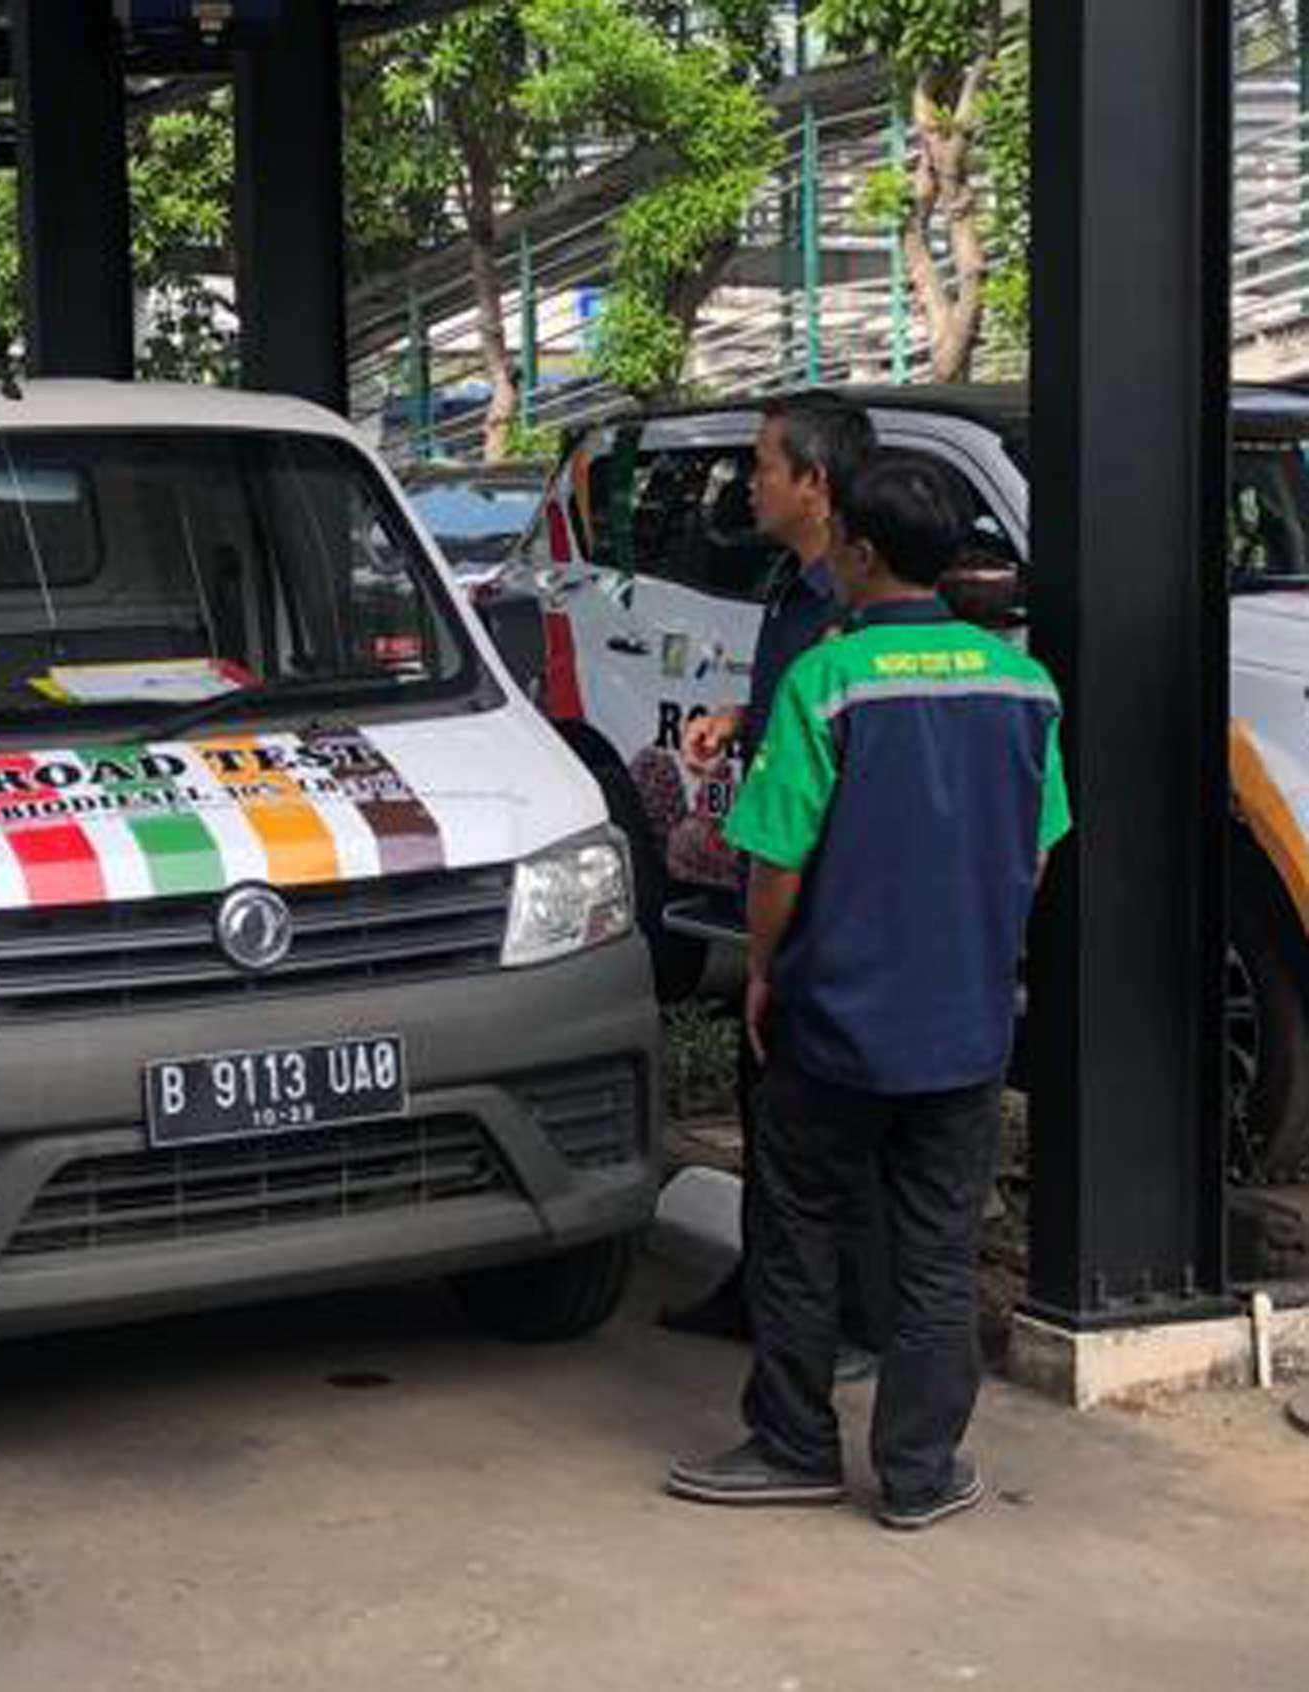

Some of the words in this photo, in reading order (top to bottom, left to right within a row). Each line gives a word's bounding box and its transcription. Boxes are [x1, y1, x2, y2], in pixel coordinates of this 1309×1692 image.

[203, 741, 390, 772] TEST
[0, 785, 210, 820] BIODIESEL
[161, 1065, 186, 1115] B
[212, 1052, 306, 1108] 9113
